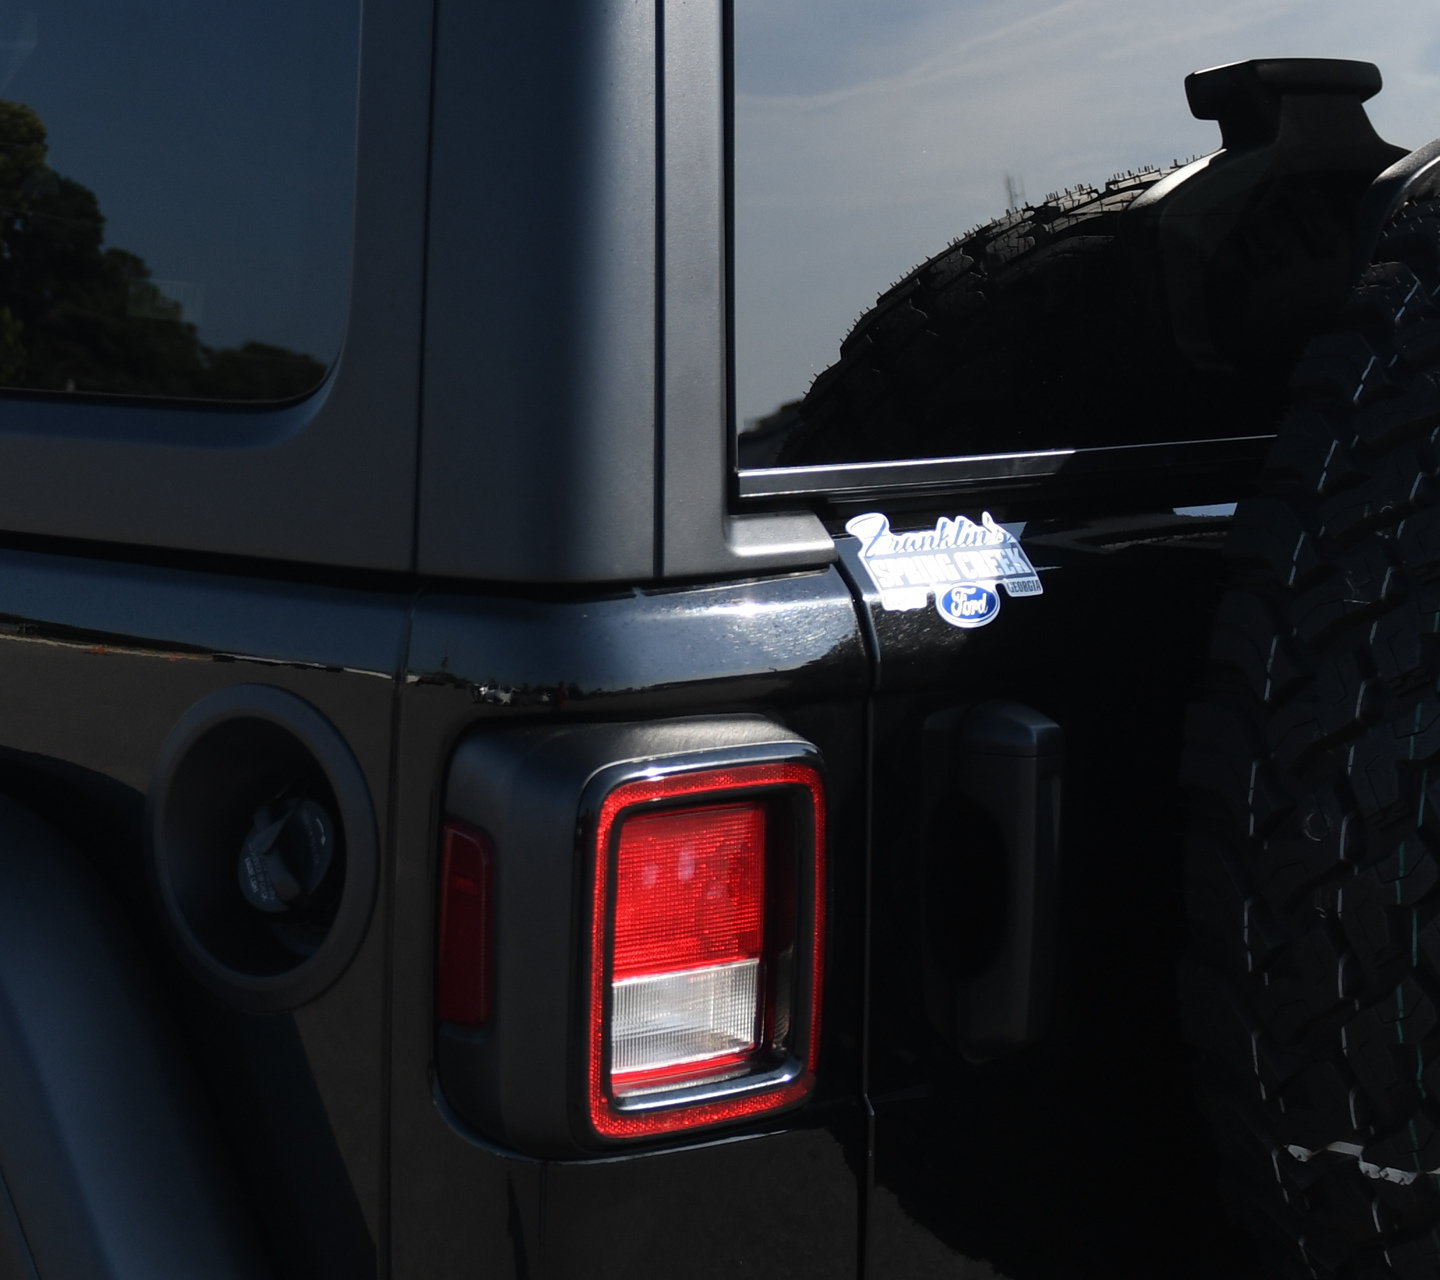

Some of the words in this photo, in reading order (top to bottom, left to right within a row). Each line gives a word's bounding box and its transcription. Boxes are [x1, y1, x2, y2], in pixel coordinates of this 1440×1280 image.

[849, 514, 1013, 557] Franklin's
[870, 552, 954, 588] SPRING
[955, 546, 1031, 581] CREEK
[951, 586, 988, 617] Ford
[1007, 579, 1041, 594] GEORGIA
